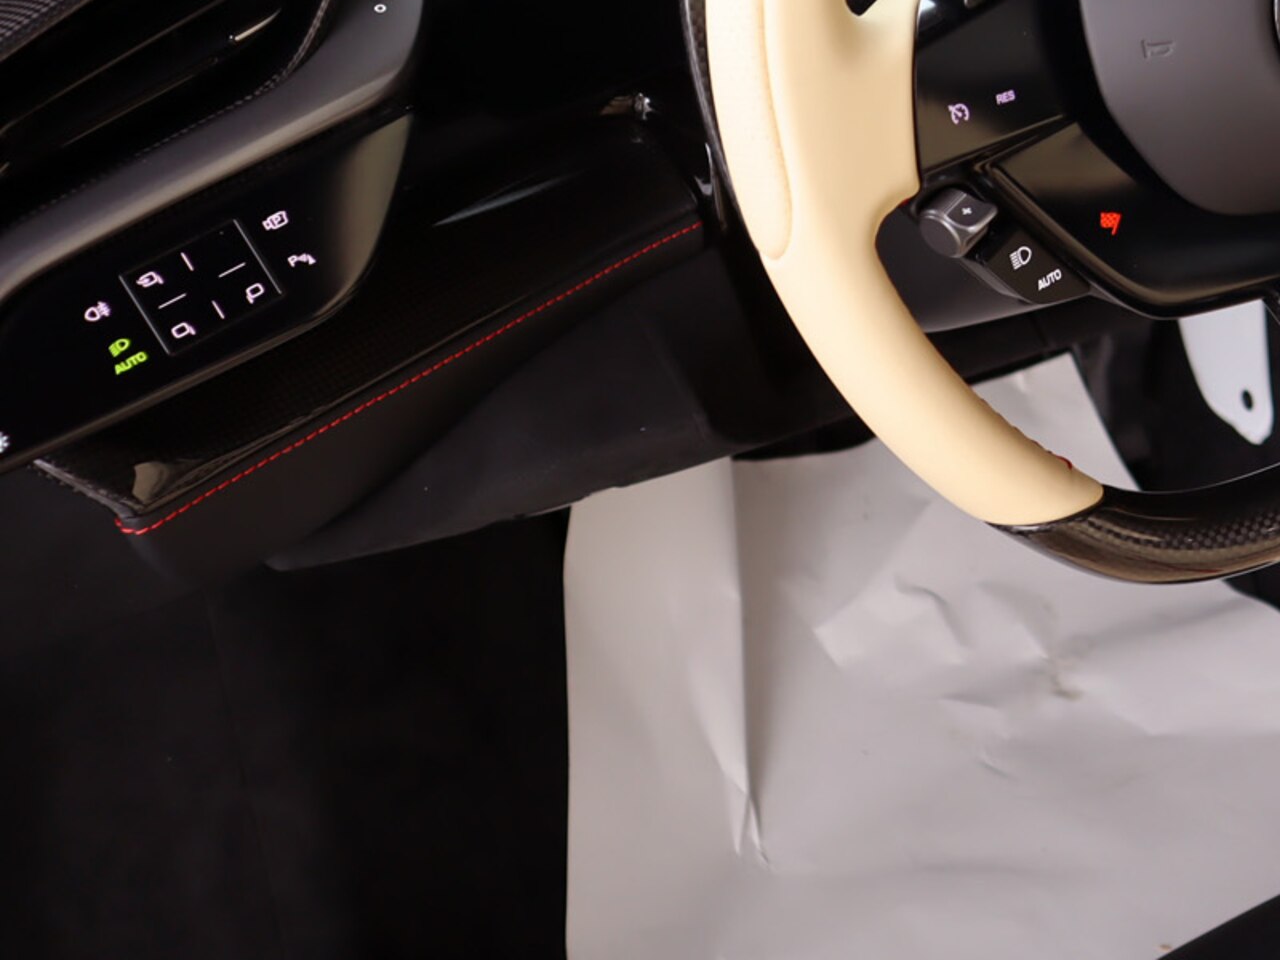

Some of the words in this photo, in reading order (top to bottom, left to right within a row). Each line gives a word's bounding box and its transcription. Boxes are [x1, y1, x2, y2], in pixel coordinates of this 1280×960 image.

[995, 89, 1016, 105] RES
[1038, 268, 1062, 291] AUTO
[114, 350, 148, 375] AUTO
